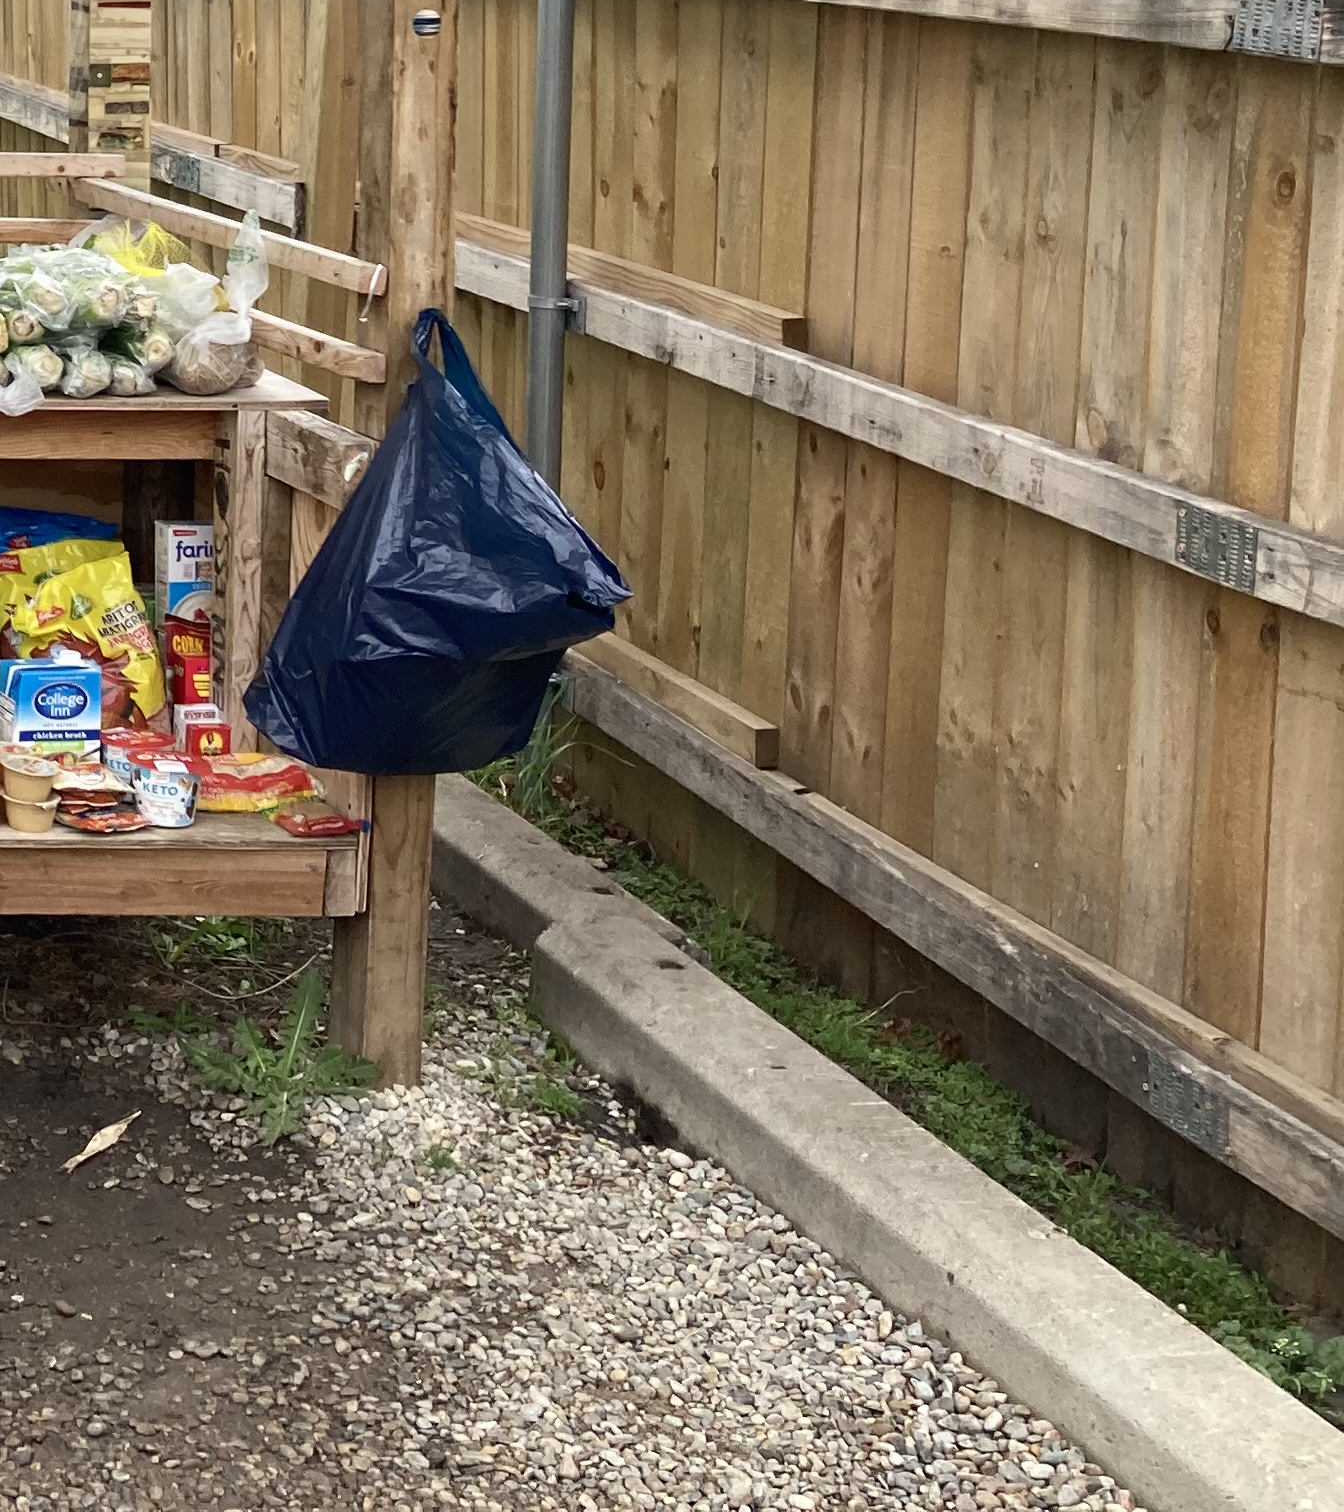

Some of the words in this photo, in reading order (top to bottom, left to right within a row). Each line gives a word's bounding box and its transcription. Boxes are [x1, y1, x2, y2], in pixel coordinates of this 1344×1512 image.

[172, 634, 204, 653] CORN
[38, 693, 84, 708] College
[50, 705, 71, 717] Inn
[32, 731, 64, 740] chicken
[64, 730, 87, 739] broth
[108, 759, 131, 772] ETO
[142, 781, 179, 797] KETO
